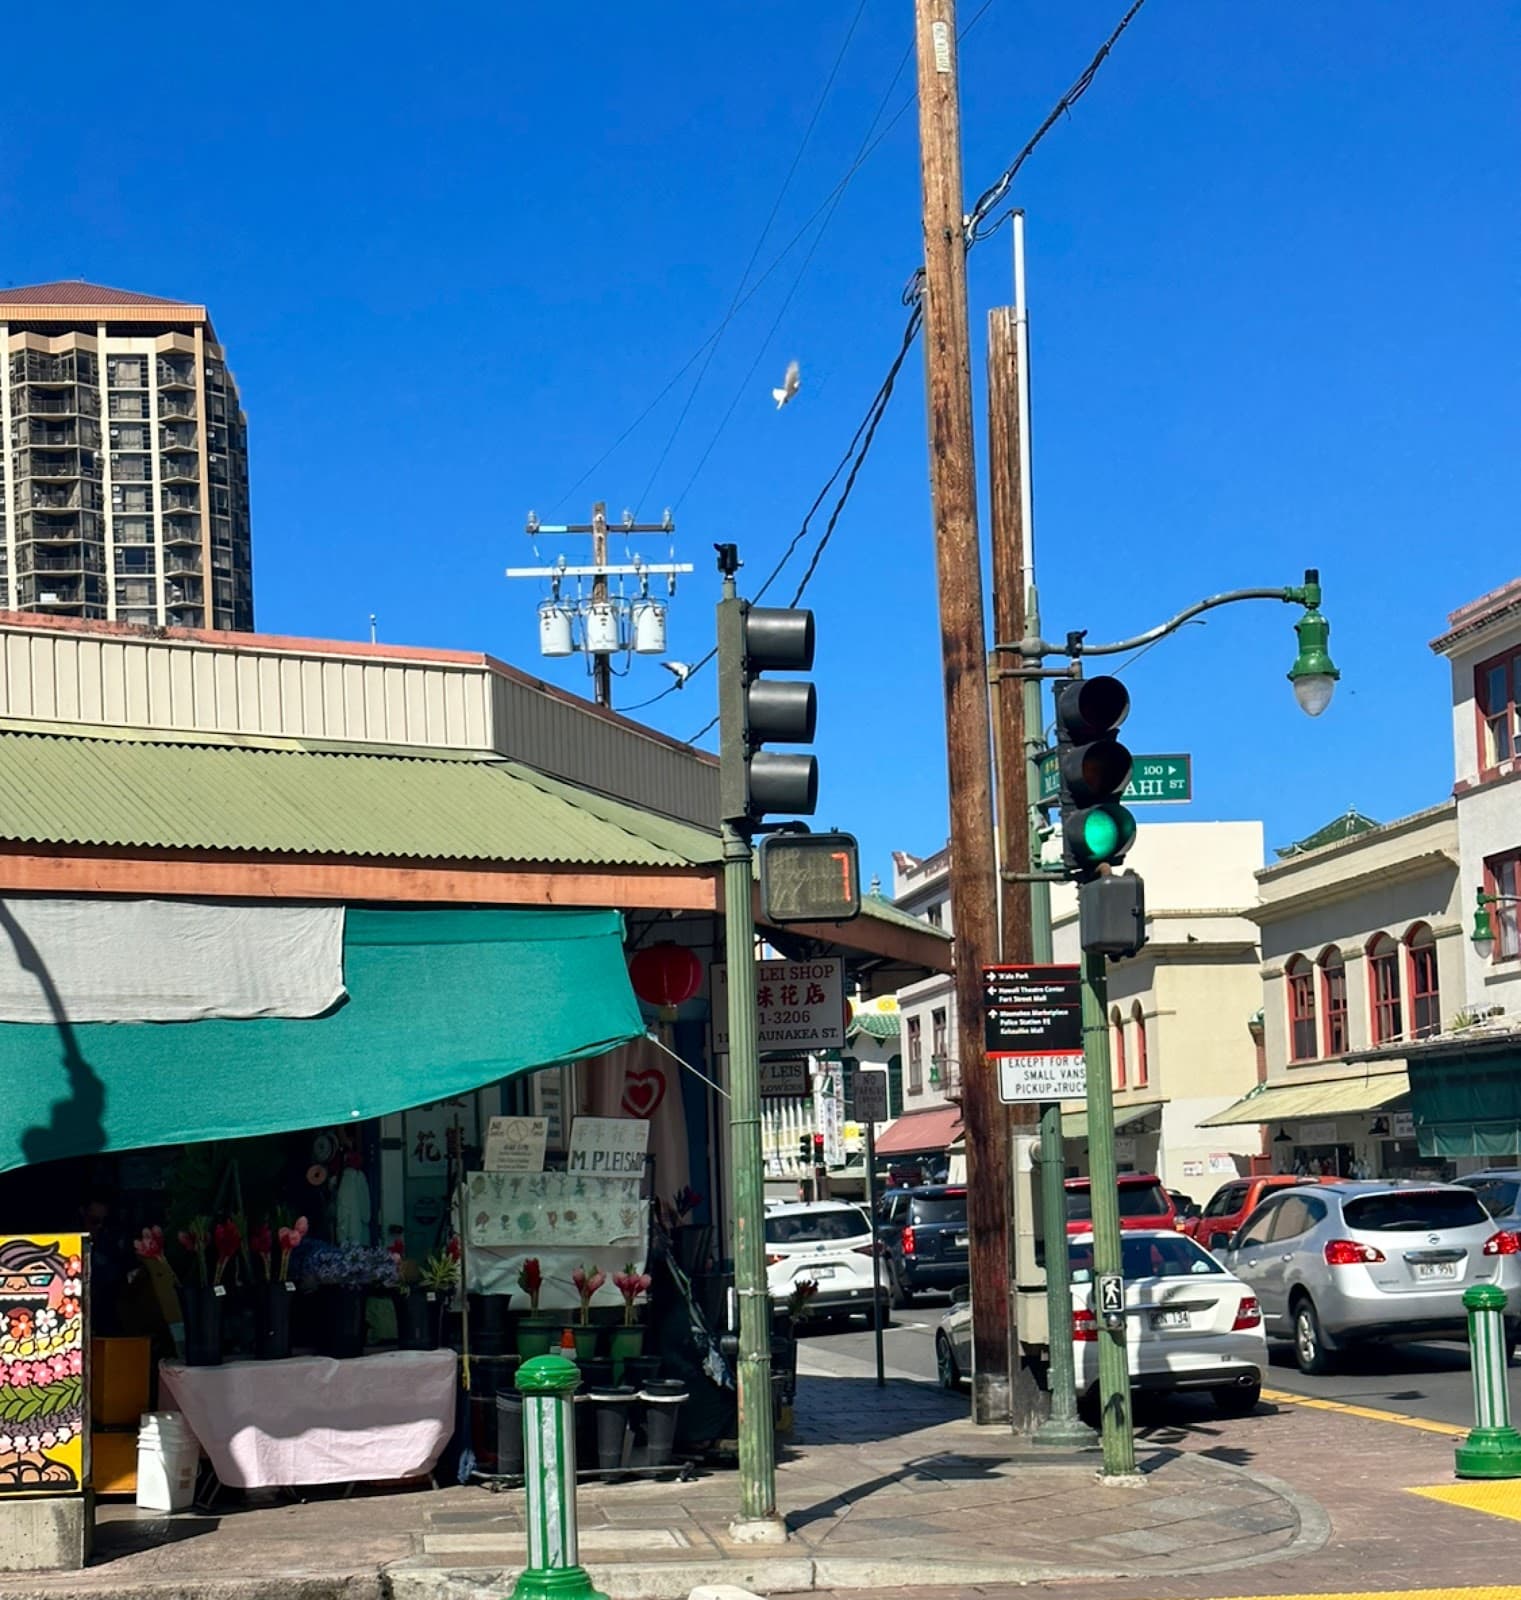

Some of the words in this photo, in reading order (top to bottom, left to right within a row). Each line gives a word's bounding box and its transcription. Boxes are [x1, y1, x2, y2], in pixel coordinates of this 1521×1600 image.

[1143, 765, 1164, 776] 100
[1122, 779, 1164, 796] AHI
[1169, 779, 1185, 789] ST
[760, 967, 785, 981] LEI
[790, 965, 835, 980] SHOP
[759, 1010, 811, 1025] 1-3206
[758, 1029, 819, 1041] AUNAKEA
[1008, 1057, 1044, 1069] EXCEPT
[1050, 1056, 1069, 1067] FOR
[1074, 1055, 1086, 1066] CA
[771, 1065, 802, 1079] LEIS
[1024, 1070, 1056, 1080] SMALL
[1015, 1083, 1052, 1094] PICKUP
